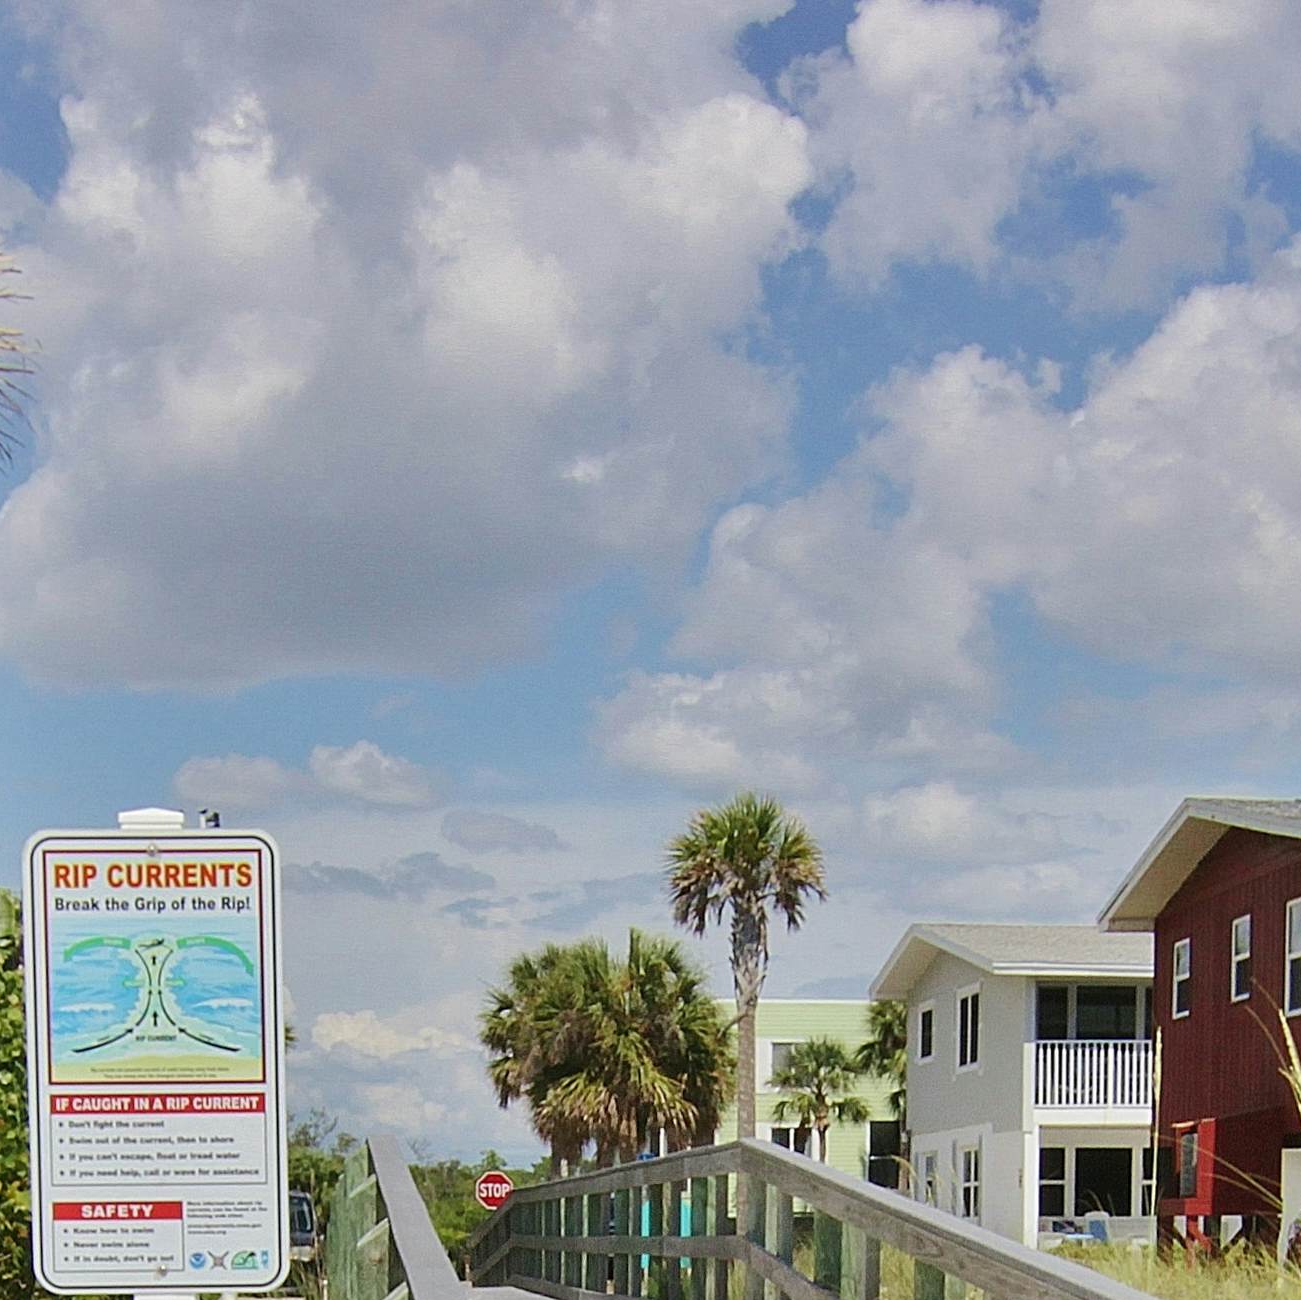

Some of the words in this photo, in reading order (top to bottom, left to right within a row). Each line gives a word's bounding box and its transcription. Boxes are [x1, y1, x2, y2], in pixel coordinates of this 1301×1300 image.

[54, 864, 97, 888] RIP
[107, 863, 252, 888] CURRENTS
[55, 898, 100, 911] Break
[105, 898, 129, 911] the
[134, 897, 166, 913] Grip
[171, 897, 186, 911] of
[192, 897, 216, 911] the
[221, 896, 250, 913] Rip!
[56, 1098, 69, 1111] IF
[72, 1098, 130, 1111] CAUGHT
[134, 1097, 149, 1110] IN
[153, 1097, 163, 1110] A
[166, 1097, 188, 1110] RIP
[193, 1096, 259, 1109] CURRENT
[93, 1121, 113, 1129] fight
[480, 1183, 509, 1198] STOP
[81, 1204, 154, 1218] SAFETY
